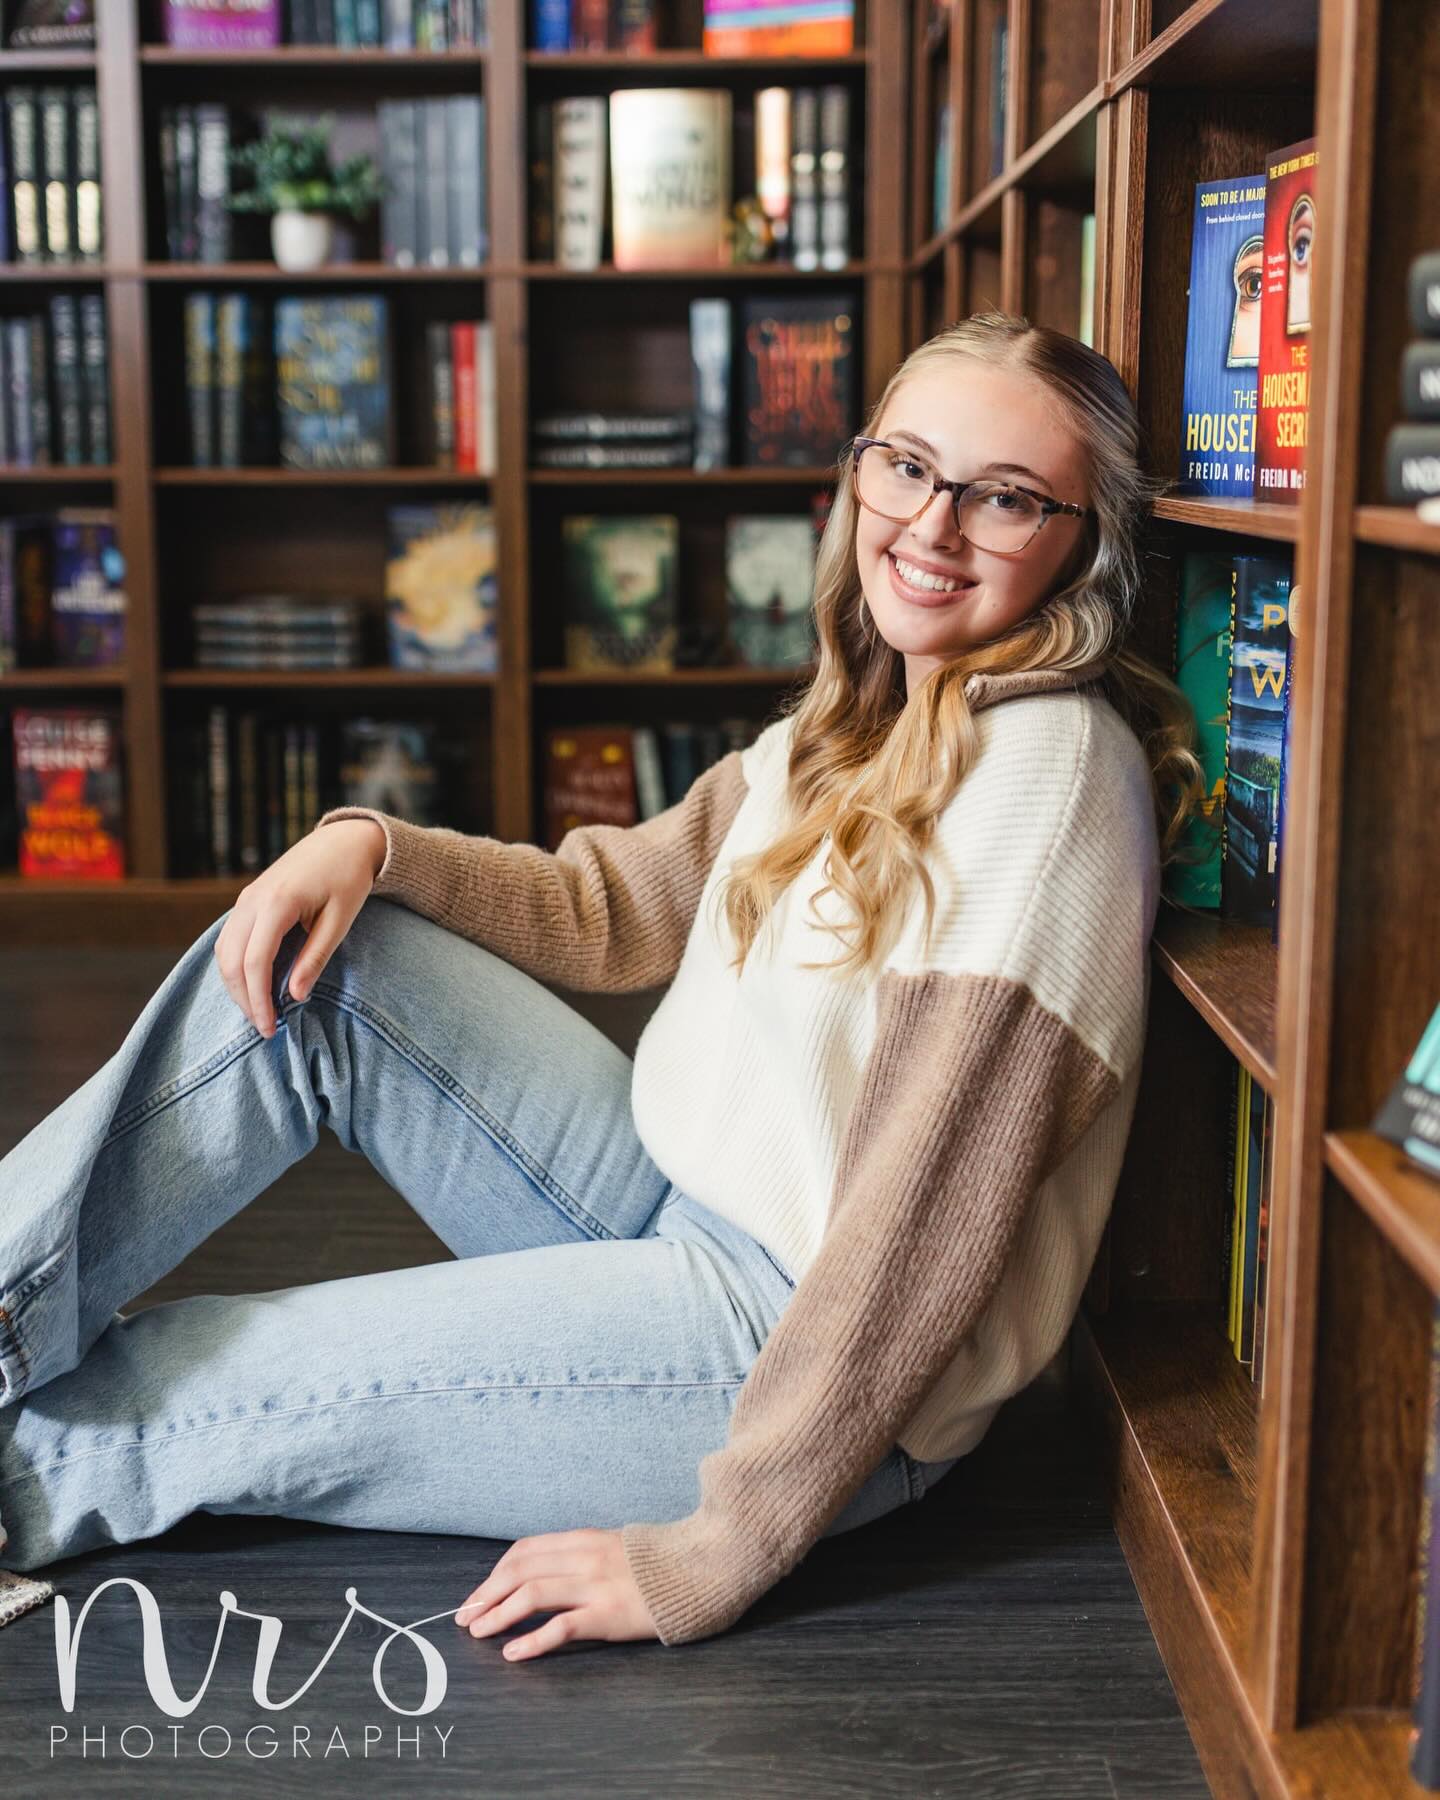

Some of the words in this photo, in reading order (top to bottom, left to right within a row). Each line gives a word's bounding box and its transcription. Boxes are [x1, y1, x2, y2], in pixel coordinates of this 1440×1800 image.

[1201, 192, 1219, 208] SOON
[1220, 191, 1229, 206] TO
[1229, 190, 1239, 205] BE
[1239, 189, 1245, 203] A
[1291, 345, 1307, 367] THE
[1233, 390, 1258, 409] THE
[1262, 371, 1312, 409] HOUSEM
[1186, 413, 1257, 453] HOUSE
[1188, 461, 1229, 480] FREIDA
[1260, 468, 1289, 489] FREIDA
